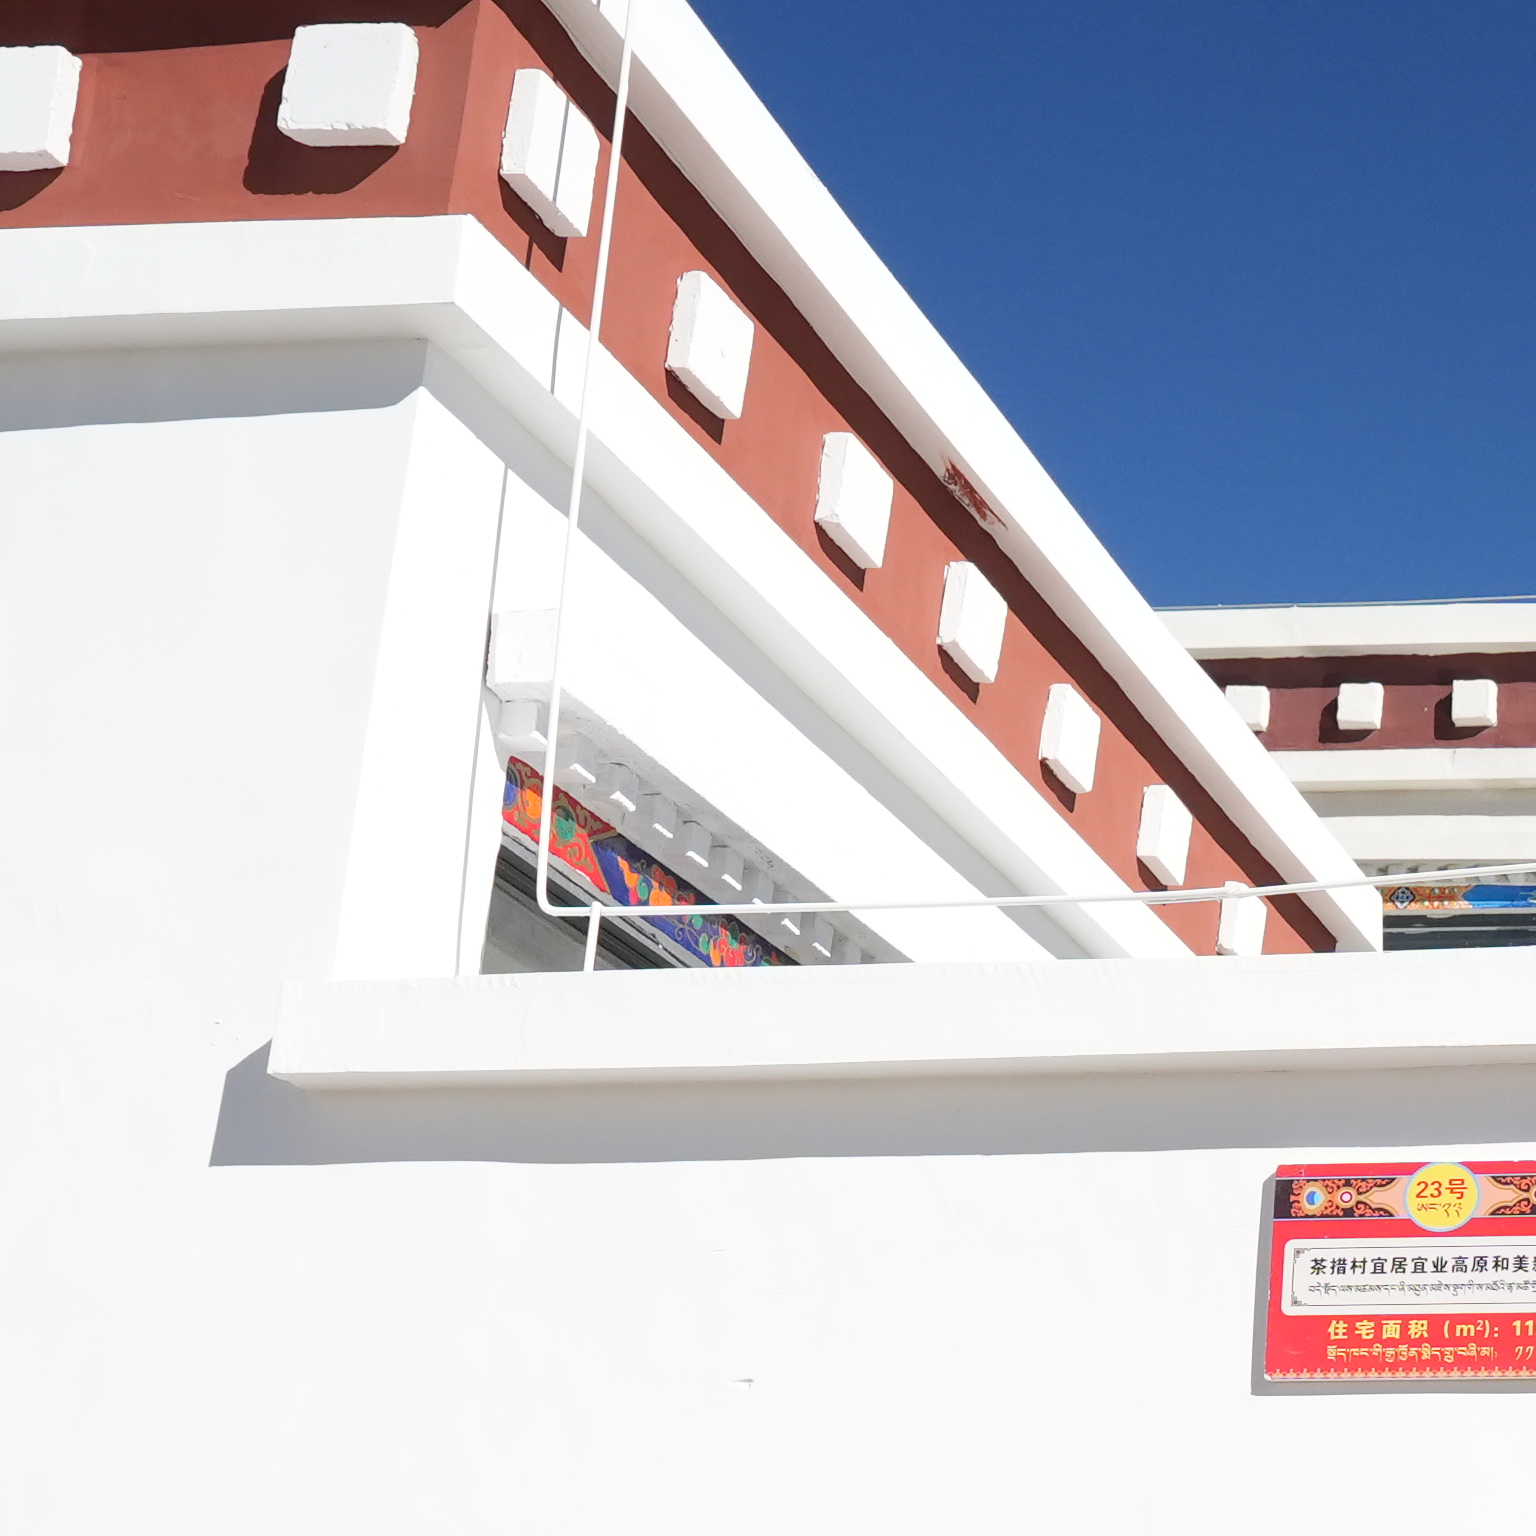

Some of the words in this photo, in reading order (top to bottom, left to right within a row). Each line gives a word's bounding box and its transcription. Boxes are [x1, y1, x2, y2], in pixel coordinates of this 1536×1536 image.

[1415, 1179, 1468, 1200] 23号
[1327, 1319, 1429, 1340] 住宅面积
